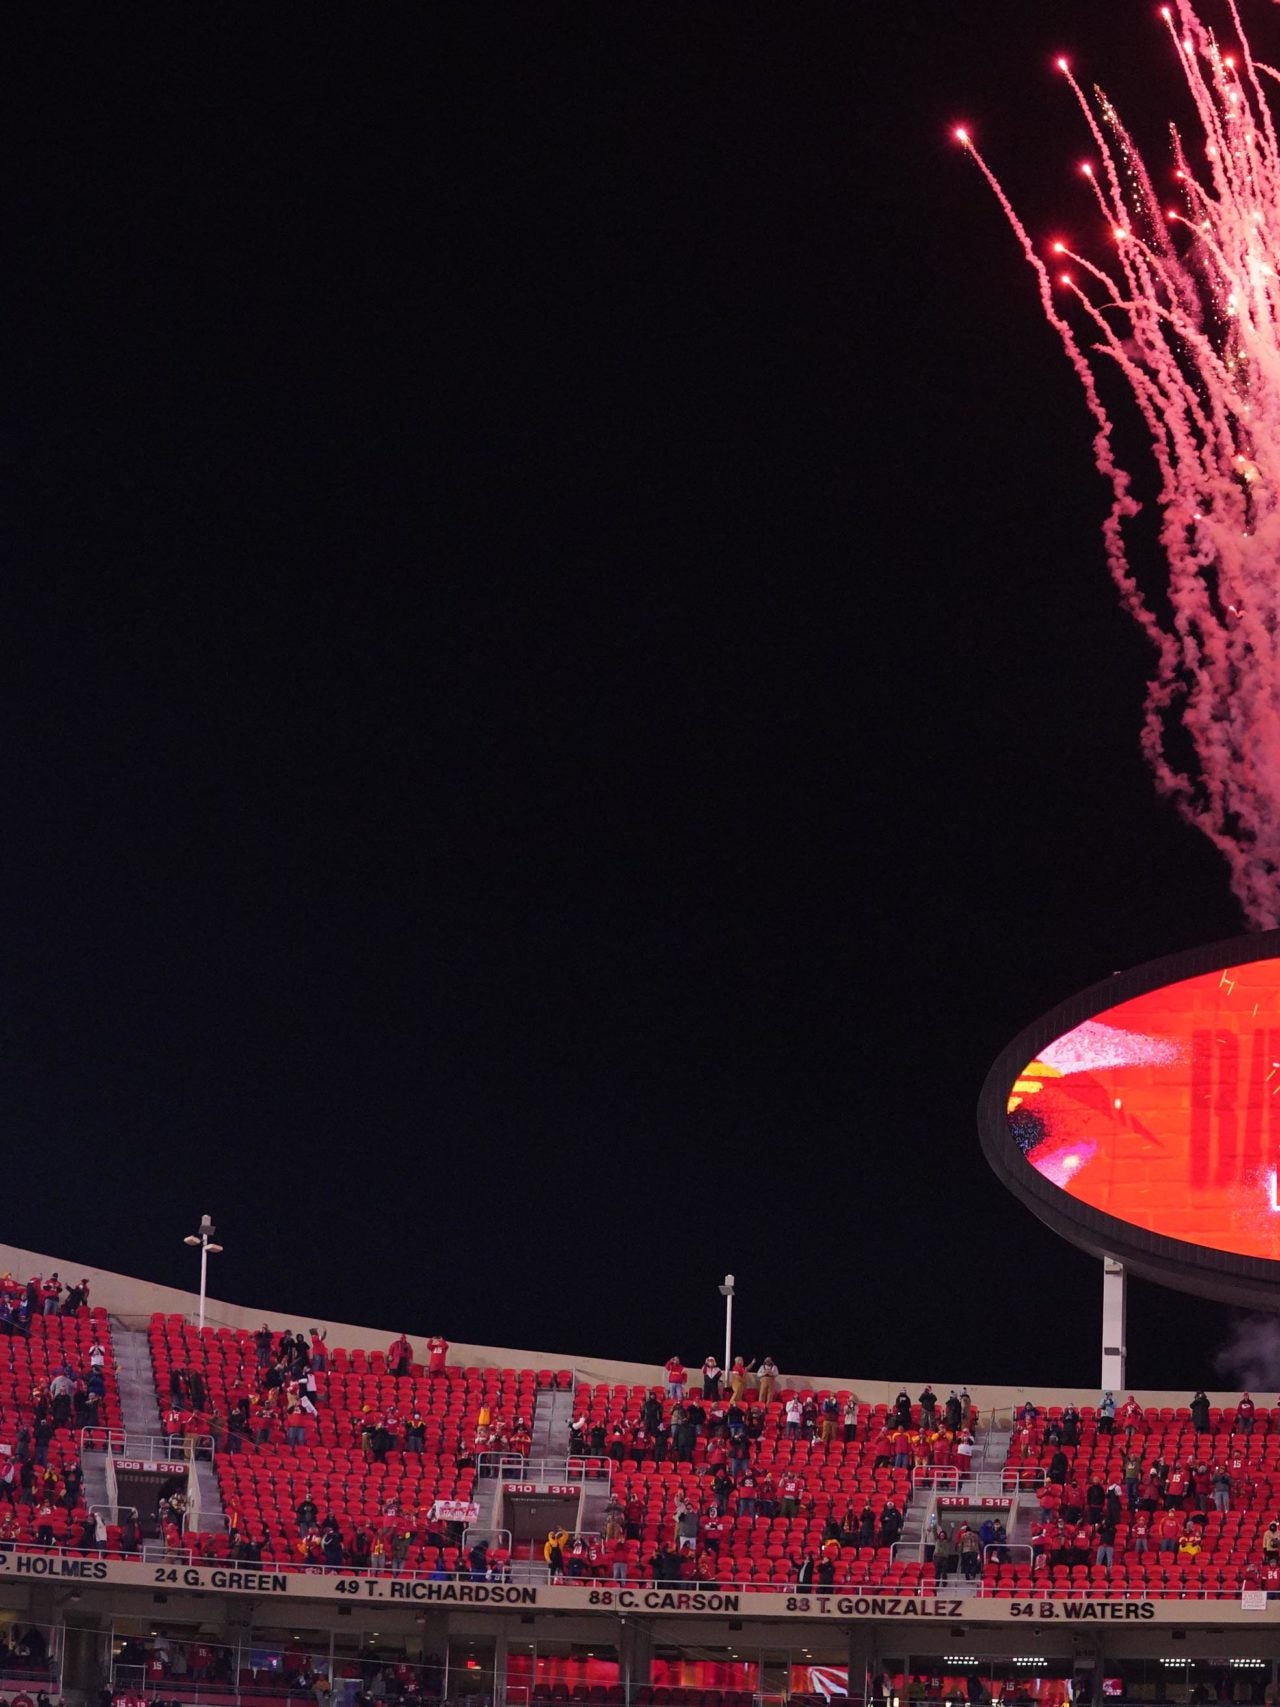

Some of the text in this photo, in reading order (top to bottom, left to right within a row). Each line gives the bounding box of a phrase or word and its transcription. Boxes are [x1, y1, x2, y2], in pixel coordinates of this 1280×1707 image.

[117, 1461, 184, 1473] 309 310
[1233, 1459, 1242, 1468] 15
[1172, 1473, 1182, 1482] 15
[508, 1485, 575, 1494] 310 311
[17, 1556, 107, 1579] HOLMES
[1267, 1570, 1278, 1579] 24
[155, 1568, 287, 1592] 24 G. GREEN
[335, 1580, 537, 1604] 49 T. RICHARDSON
[589, 1591, 739, 1611] 88 C. CARSON
[786, 1597, 962, 1617] 88 T. GONZALEZ
[1010, 1602, 1155, 1619] 54 B. WATERS
[153, 1661, 162, 1670] 15
[932, 1678, 940, 1687] 15
[1006, 1682, 1015, 1691] 15
